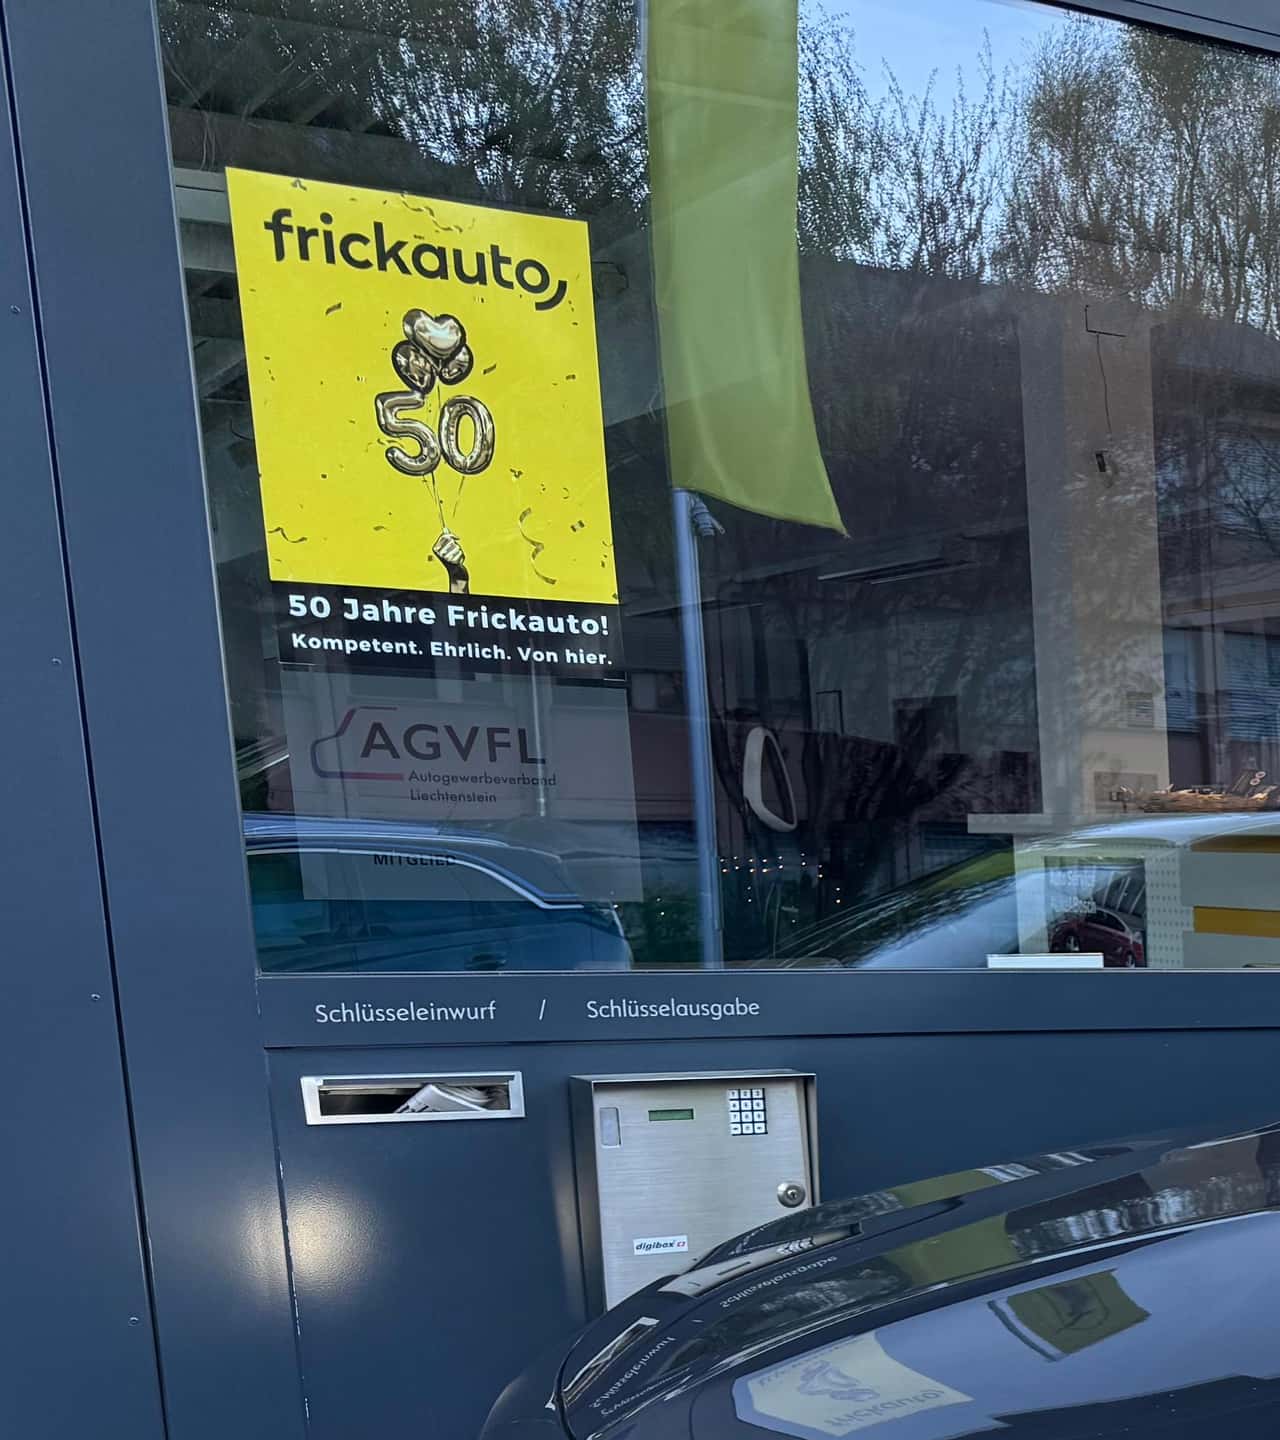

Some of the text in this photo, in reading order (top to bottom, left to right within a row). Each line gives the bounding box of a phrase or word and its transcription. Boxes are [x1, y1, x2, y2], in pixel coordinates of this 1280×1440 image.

[374, 391, 495, 477] 50
[288, 594, 609, 636] 50 Jahre Frickauto!
[291, 633, 613, 666] Kompetent. Ehrlich. Von hier.
[360, 721, 547, 765] AGVFL
[410, 789, 497, 804] Liechtenstein
[315, 1000, 497, 1026] Schlüsseleinwurf
[586, 998, 761, 1022] Schlüsselausgabe
[635, 1240, 675, 1252] digibox
